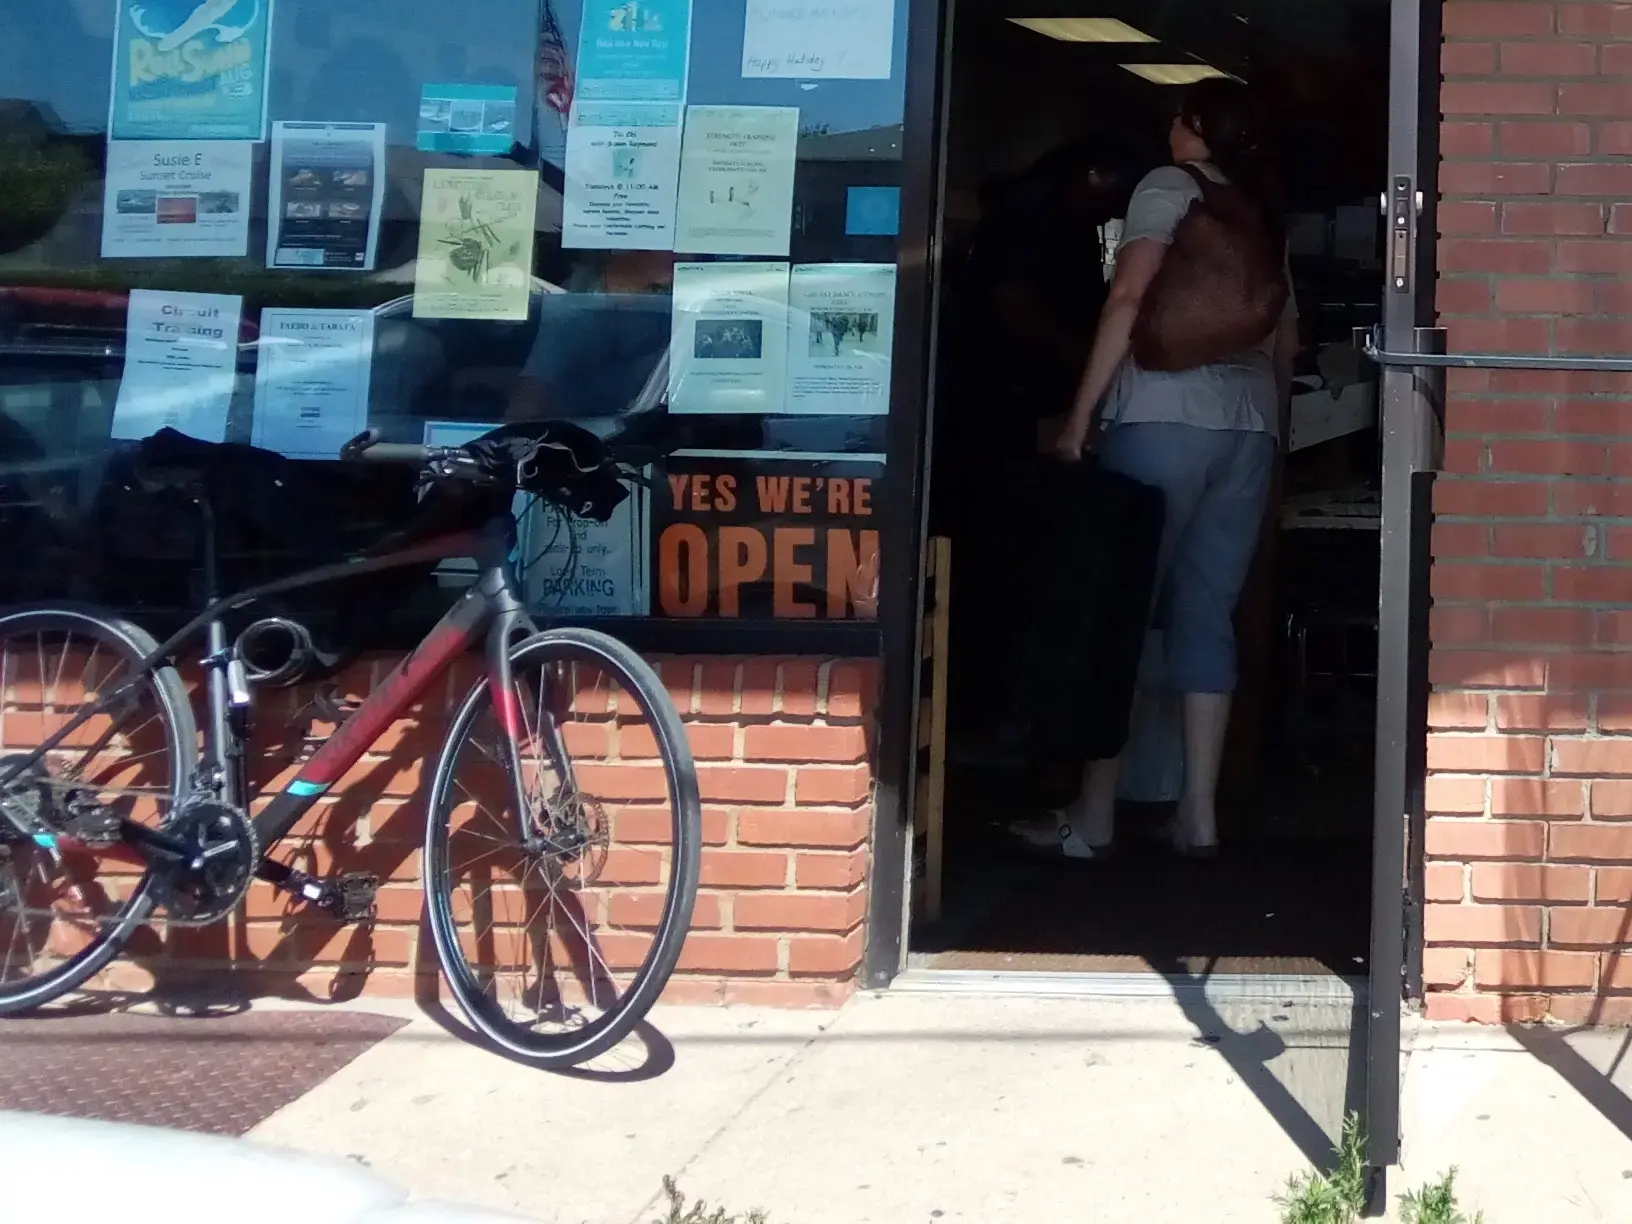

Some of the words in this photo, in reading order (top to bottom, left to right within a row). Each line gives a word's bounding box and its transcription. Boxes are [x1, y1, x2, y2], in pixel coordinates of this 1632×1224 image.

[153, 153, 190, 167] Susie
[194, 153, 203, 166] E
[139, 170, 175, 181] Sunset
[178, 170, 213, 181] Cruise
[161, 304, 220, 318] Ciuit
[152, 321, 224, 339] Traing
[669, 474, 737, 512] YES
[756, 474, 873, 515] WE'RE
[658, 522, 881, 620] OPEN
[542, 578, 615, 597] PARKING
